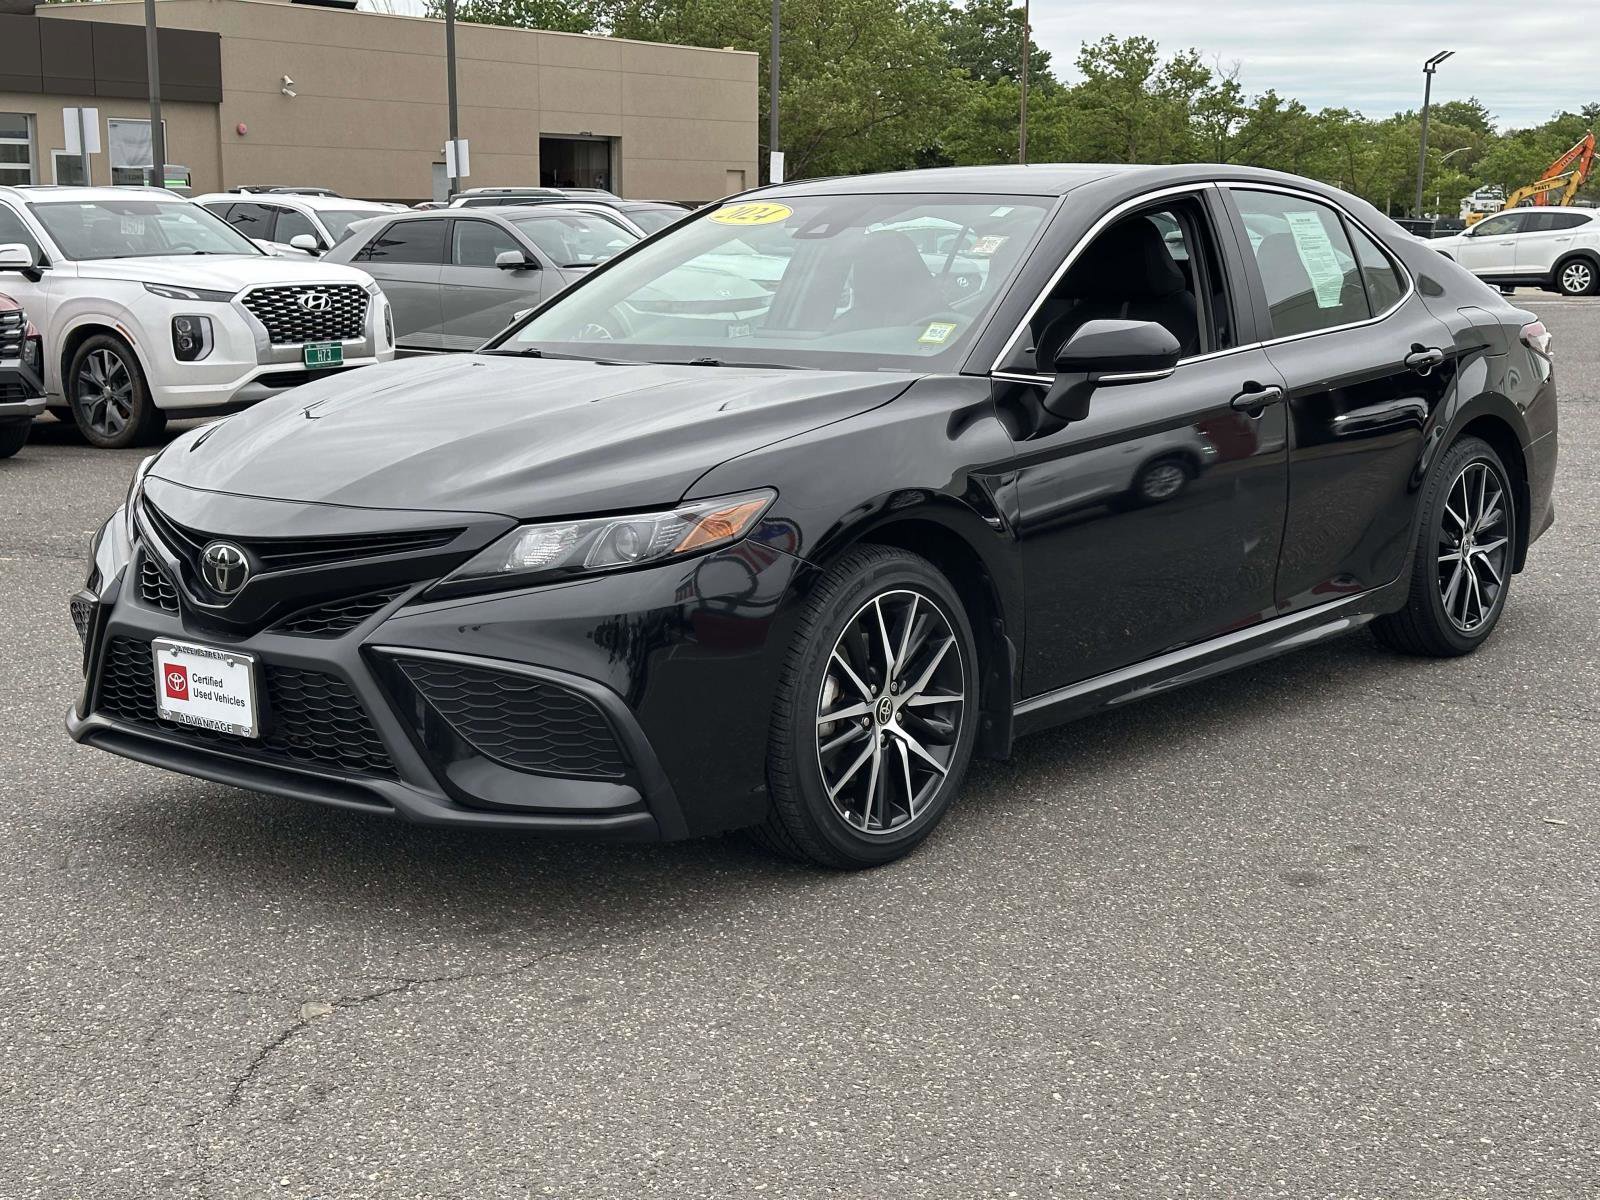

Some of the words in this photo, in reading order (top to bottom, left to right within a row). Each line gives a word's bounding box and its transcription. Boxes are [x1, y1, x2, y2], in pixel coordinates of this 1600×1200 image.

[715, 207, 786, 221] 2024
[317, 349, 332, 362] H73
[192, 673, 223, 688] Certified
[193, 688, 213, 701] Used
[214, 693, 246, 707] Vehicles
[179, 714, 233, 733] ADVANTAGE
